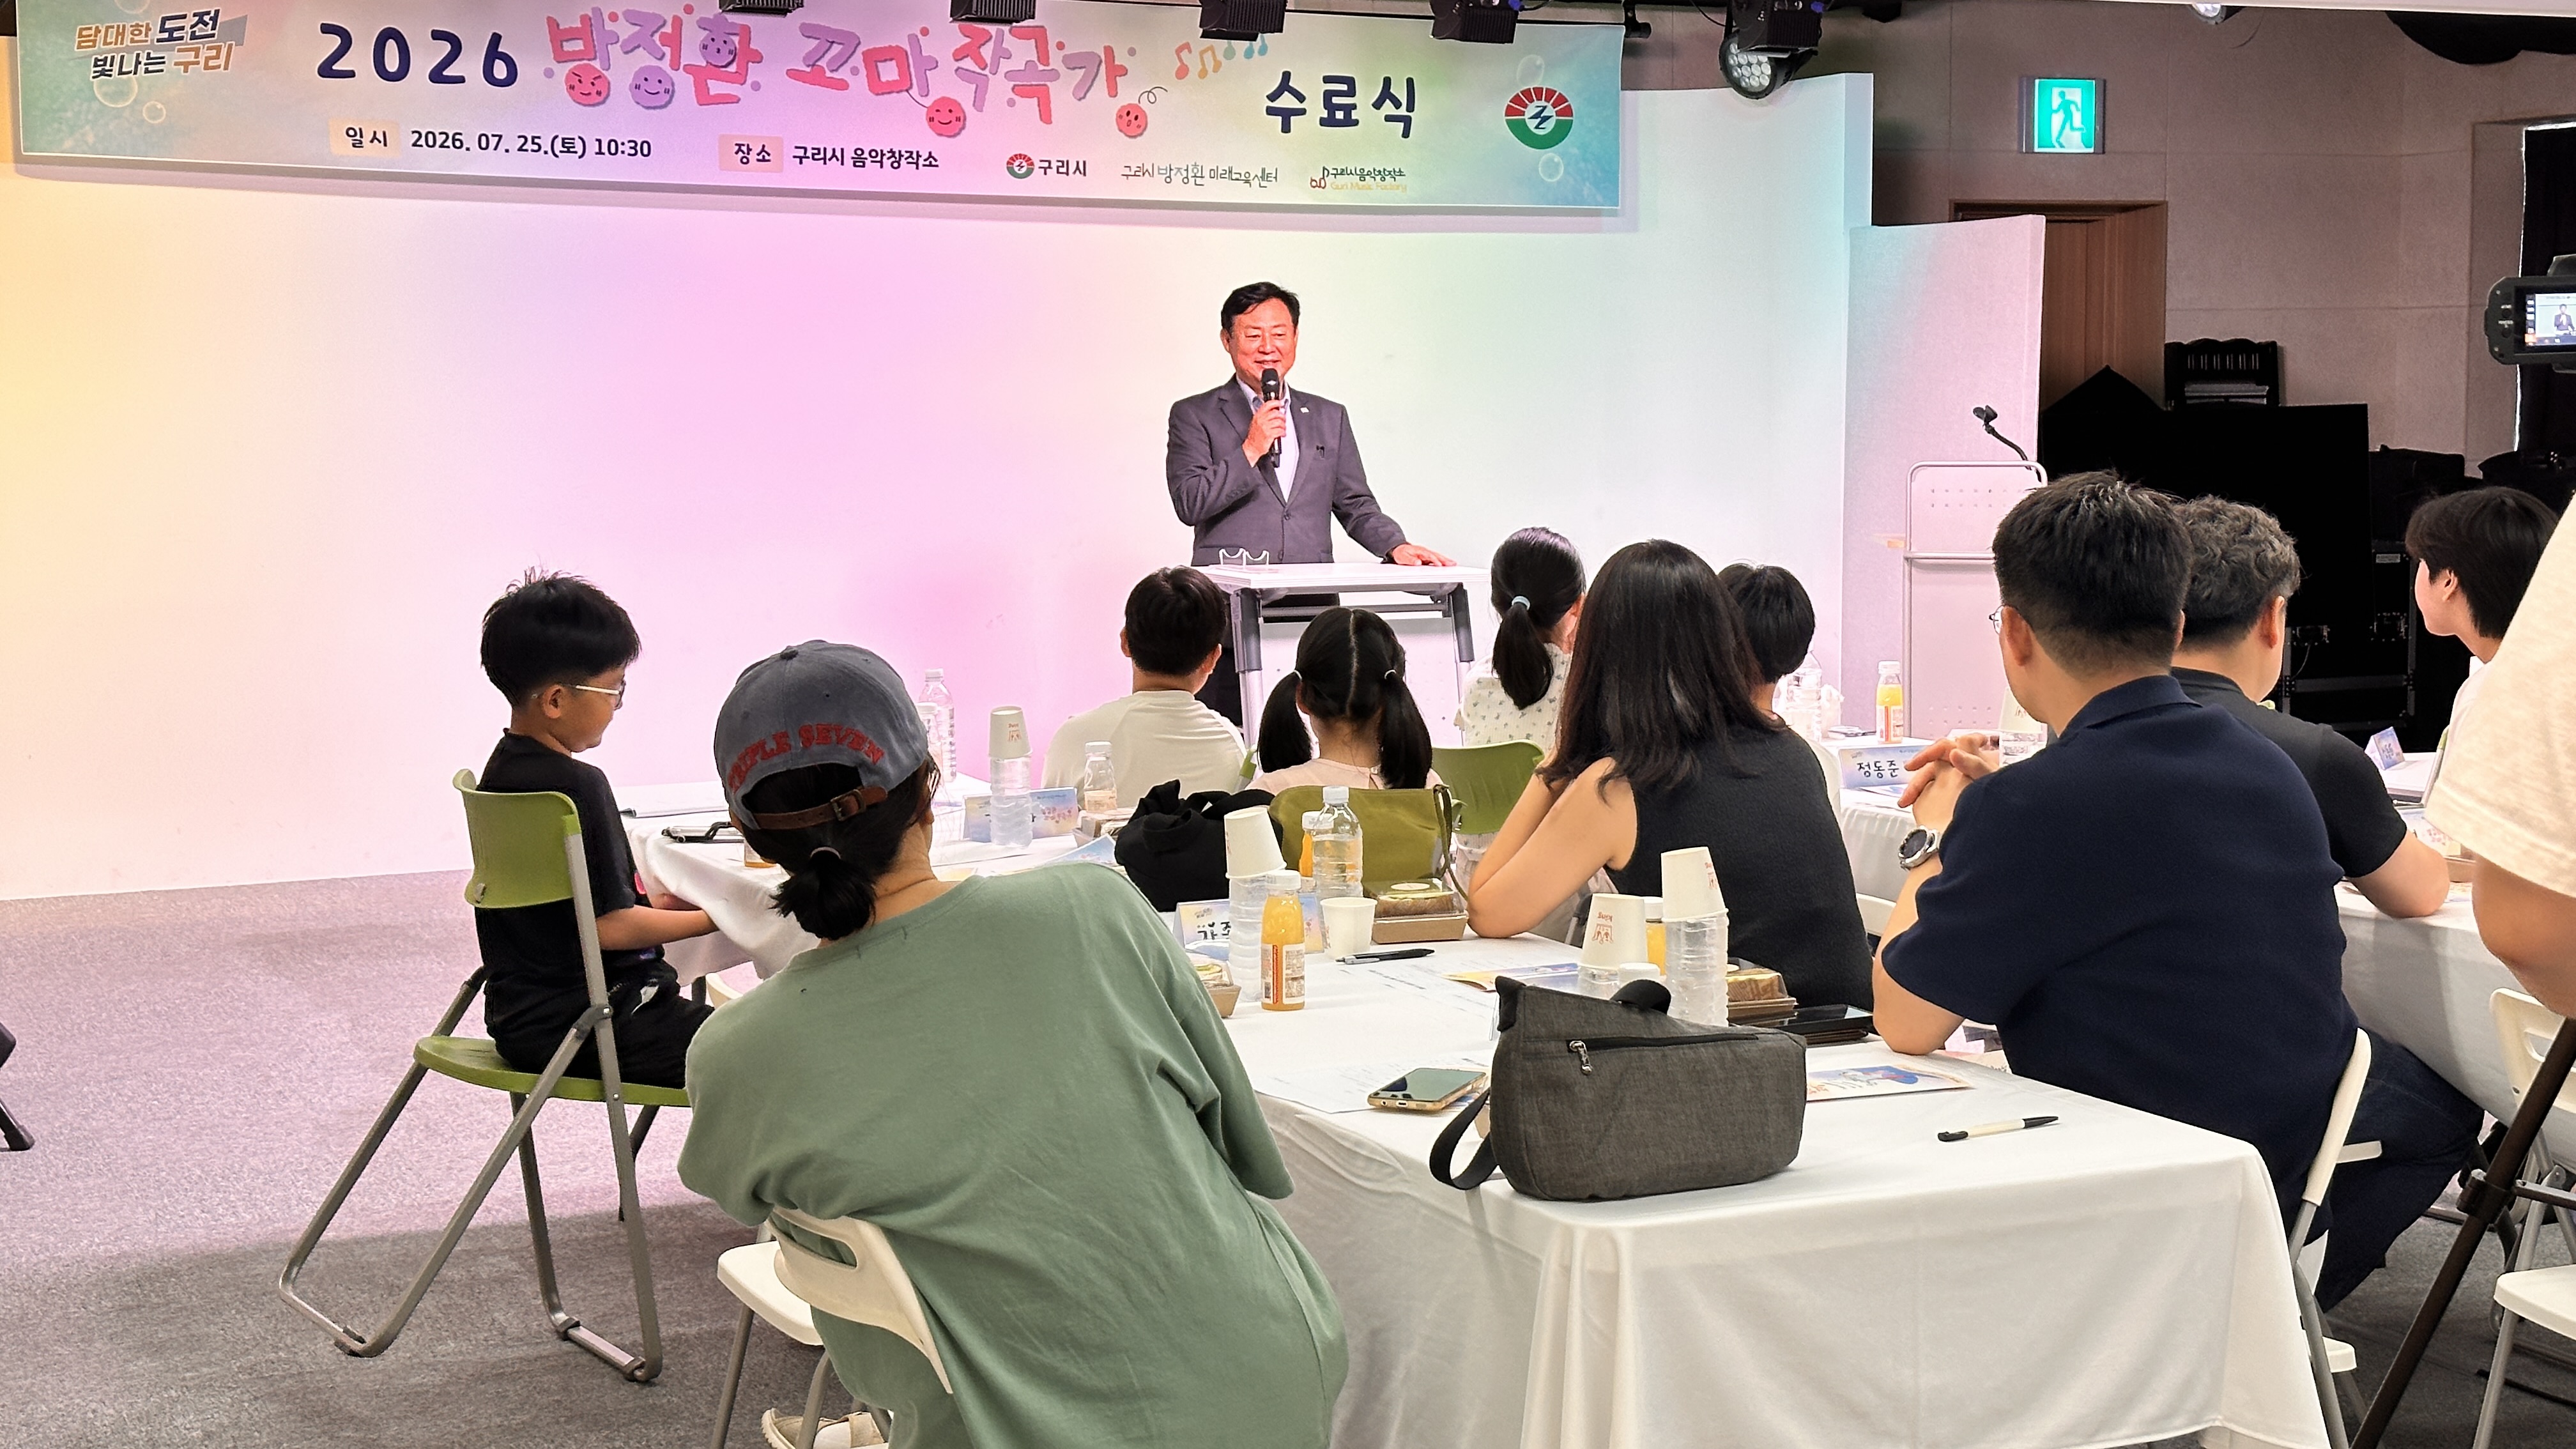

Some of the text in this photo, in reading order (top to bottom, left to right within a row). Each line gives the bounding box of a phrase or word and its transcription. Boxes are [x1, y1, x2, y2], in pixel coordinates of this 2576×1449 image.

[76, 9, 220, 50] 담대한 도전
[91, 43, 234, 79] 빛나는 구리
[317, 6, 1415, 139] 2026 방정환 꼬마 작곡가 수료식
[411, 130, 471, 151] 2026.
[477, 134, 510, 153] 07.
[517, 135, 586, 159] 25.(토)
[595, 138, 652, 158] 10:30
[792, 146, 845, 166] 구리시
[851, 148, 939, 169] 음악창작소
[1038, 158, 1087, 177] 구리시
[1121, 163, 1154, 180] 구리시
[1157, 162, 1205, 187] 방정환
[798, 723, 884, 765] SEVEN
[1857, 760, 1899, 779] 정동준
